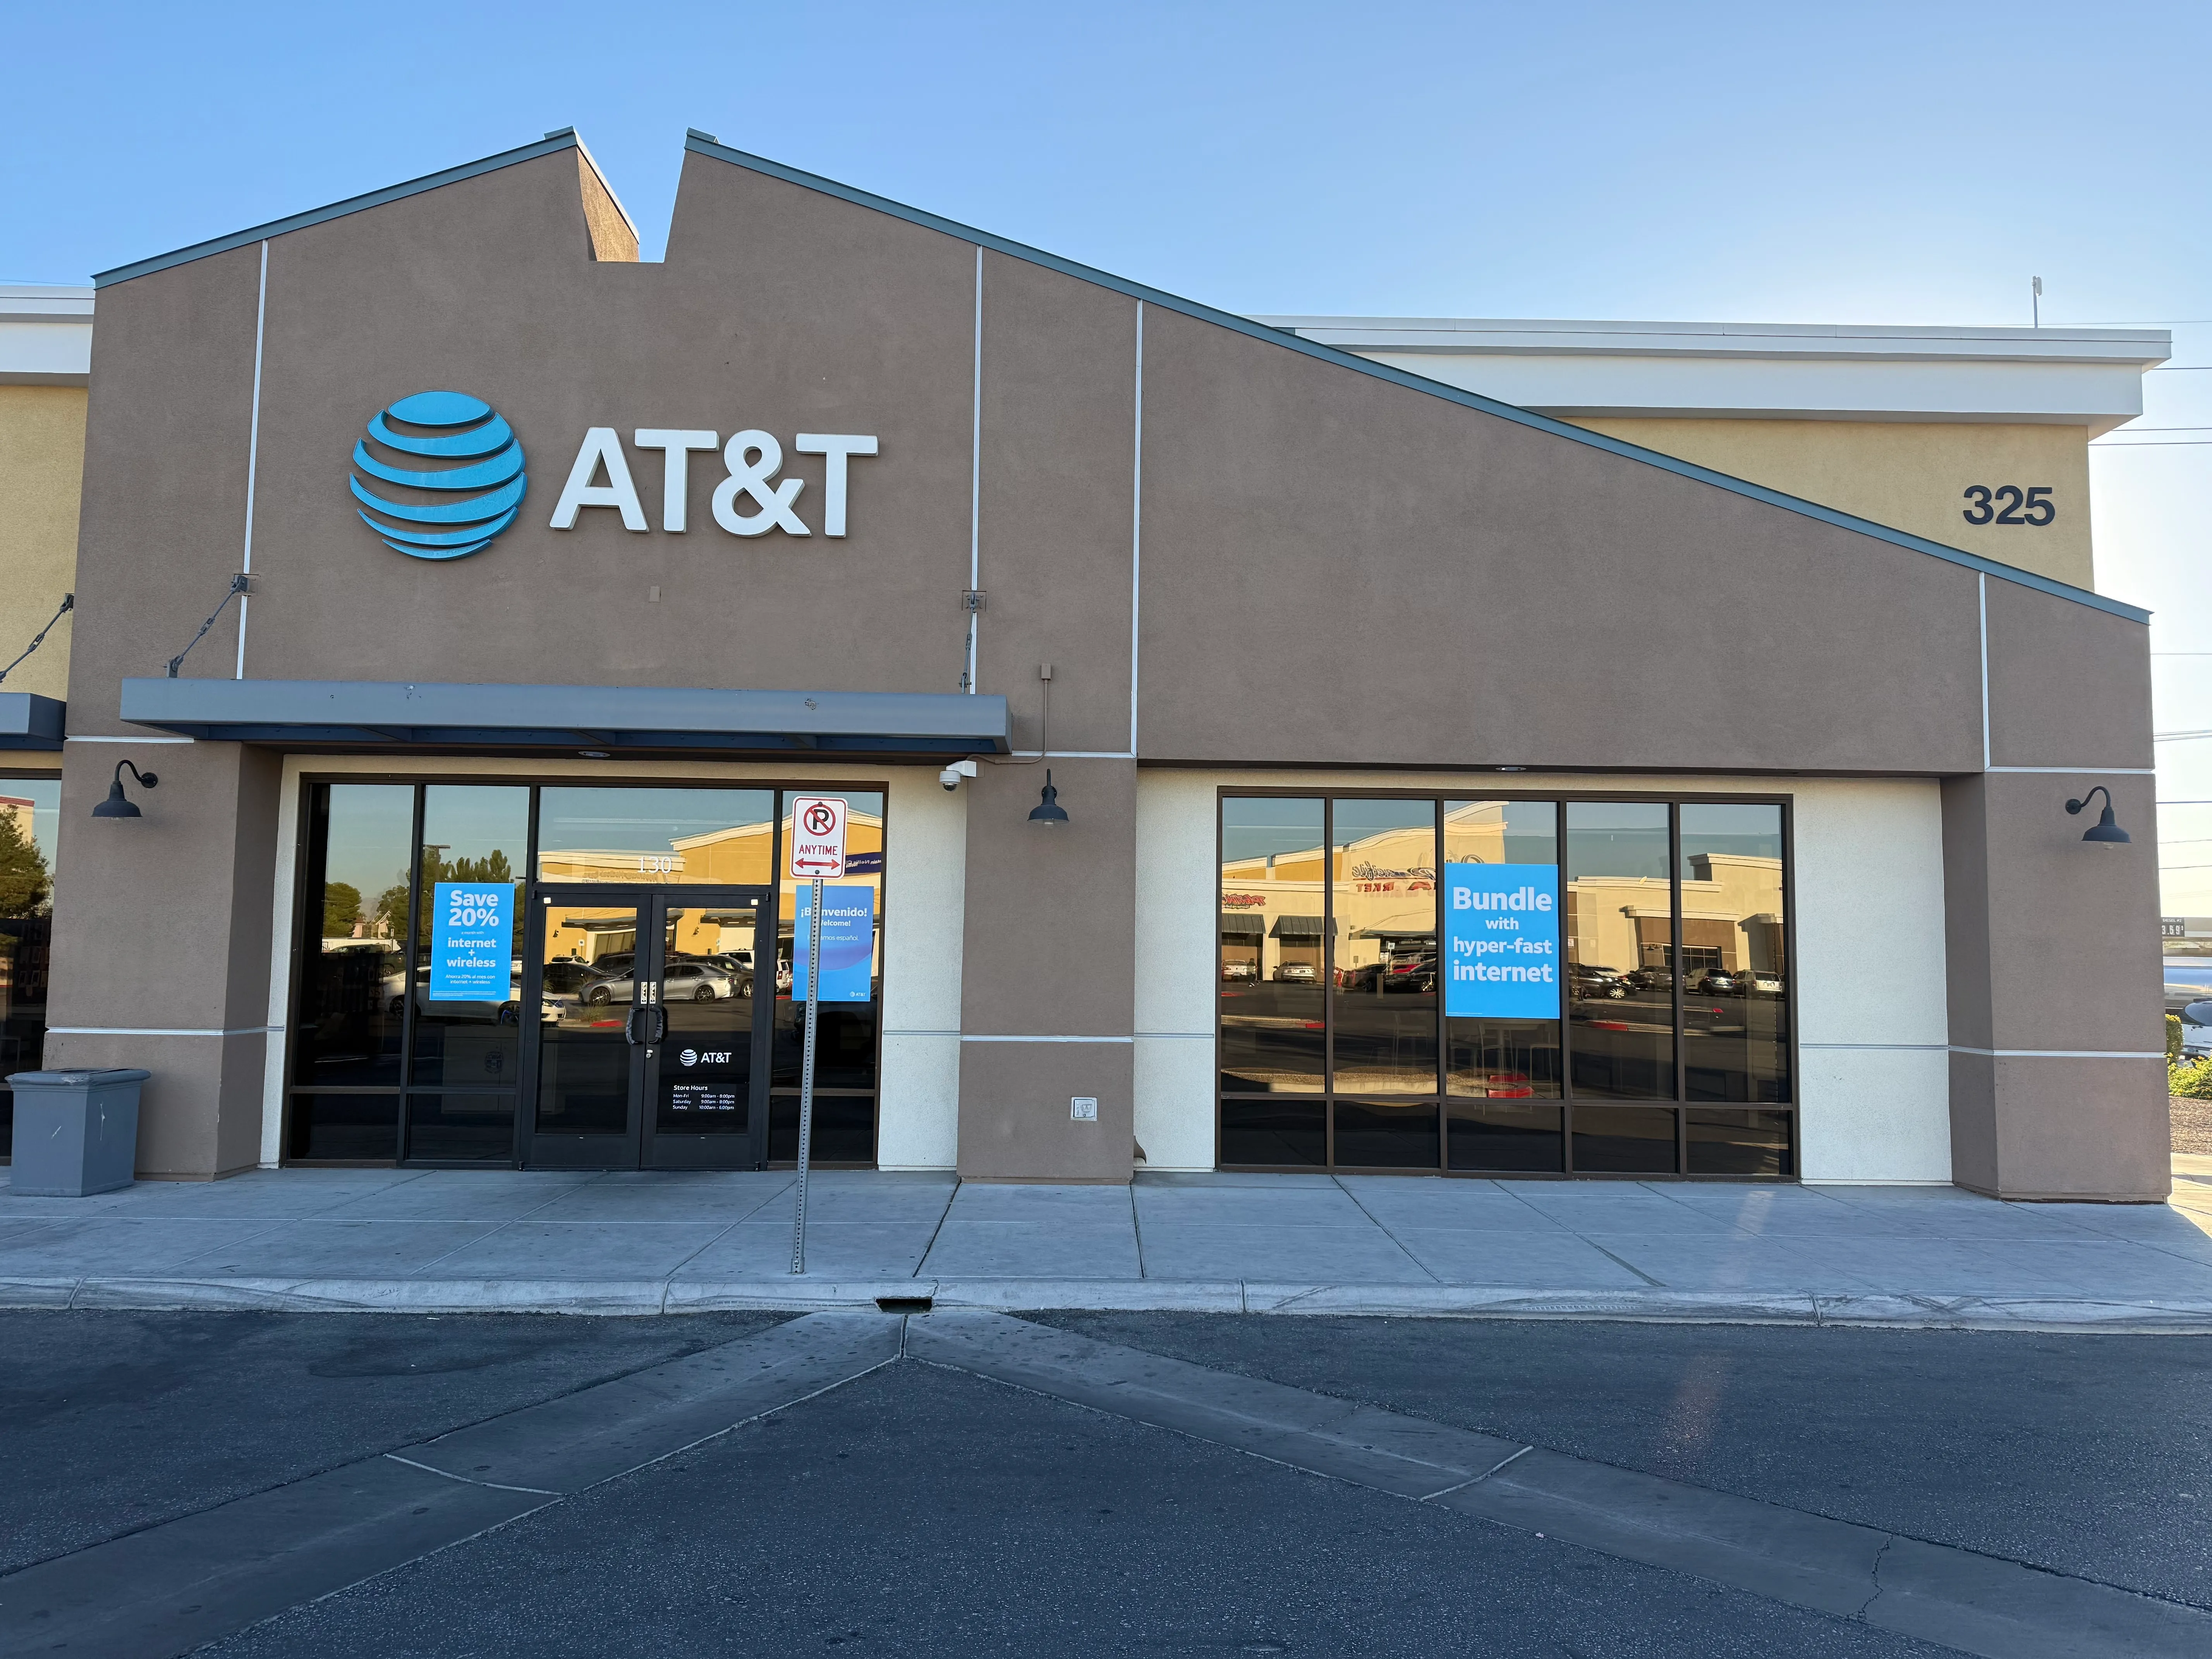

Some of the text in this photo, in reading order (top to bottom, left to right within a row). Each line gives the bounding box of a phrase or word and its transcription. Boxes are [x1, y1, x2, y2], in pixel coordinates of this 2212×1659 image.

[549, 426, 879, 538] AT&T
[1963, 485, 2056, 526] 325
[799, 844, 838, 855] ANYTIME
[637, 856, 672, 874] 130
[450, 890, 498, 907] Save
[1453, 886, 1552, 911] Bundle
[448, 908, 499, 927] 20%
[800, 907, 867, 918] ¡Bnvenido!
[1485, 917, 1519, 930] with
[448, 937, 496, 948] internet
[1453, 936, 1553, 957] hyper-fast
[447, 957, 496, 967] wireless
[1453, 959, 1553, 982] internet
[701, 1052, 732, 1063] AT&T
